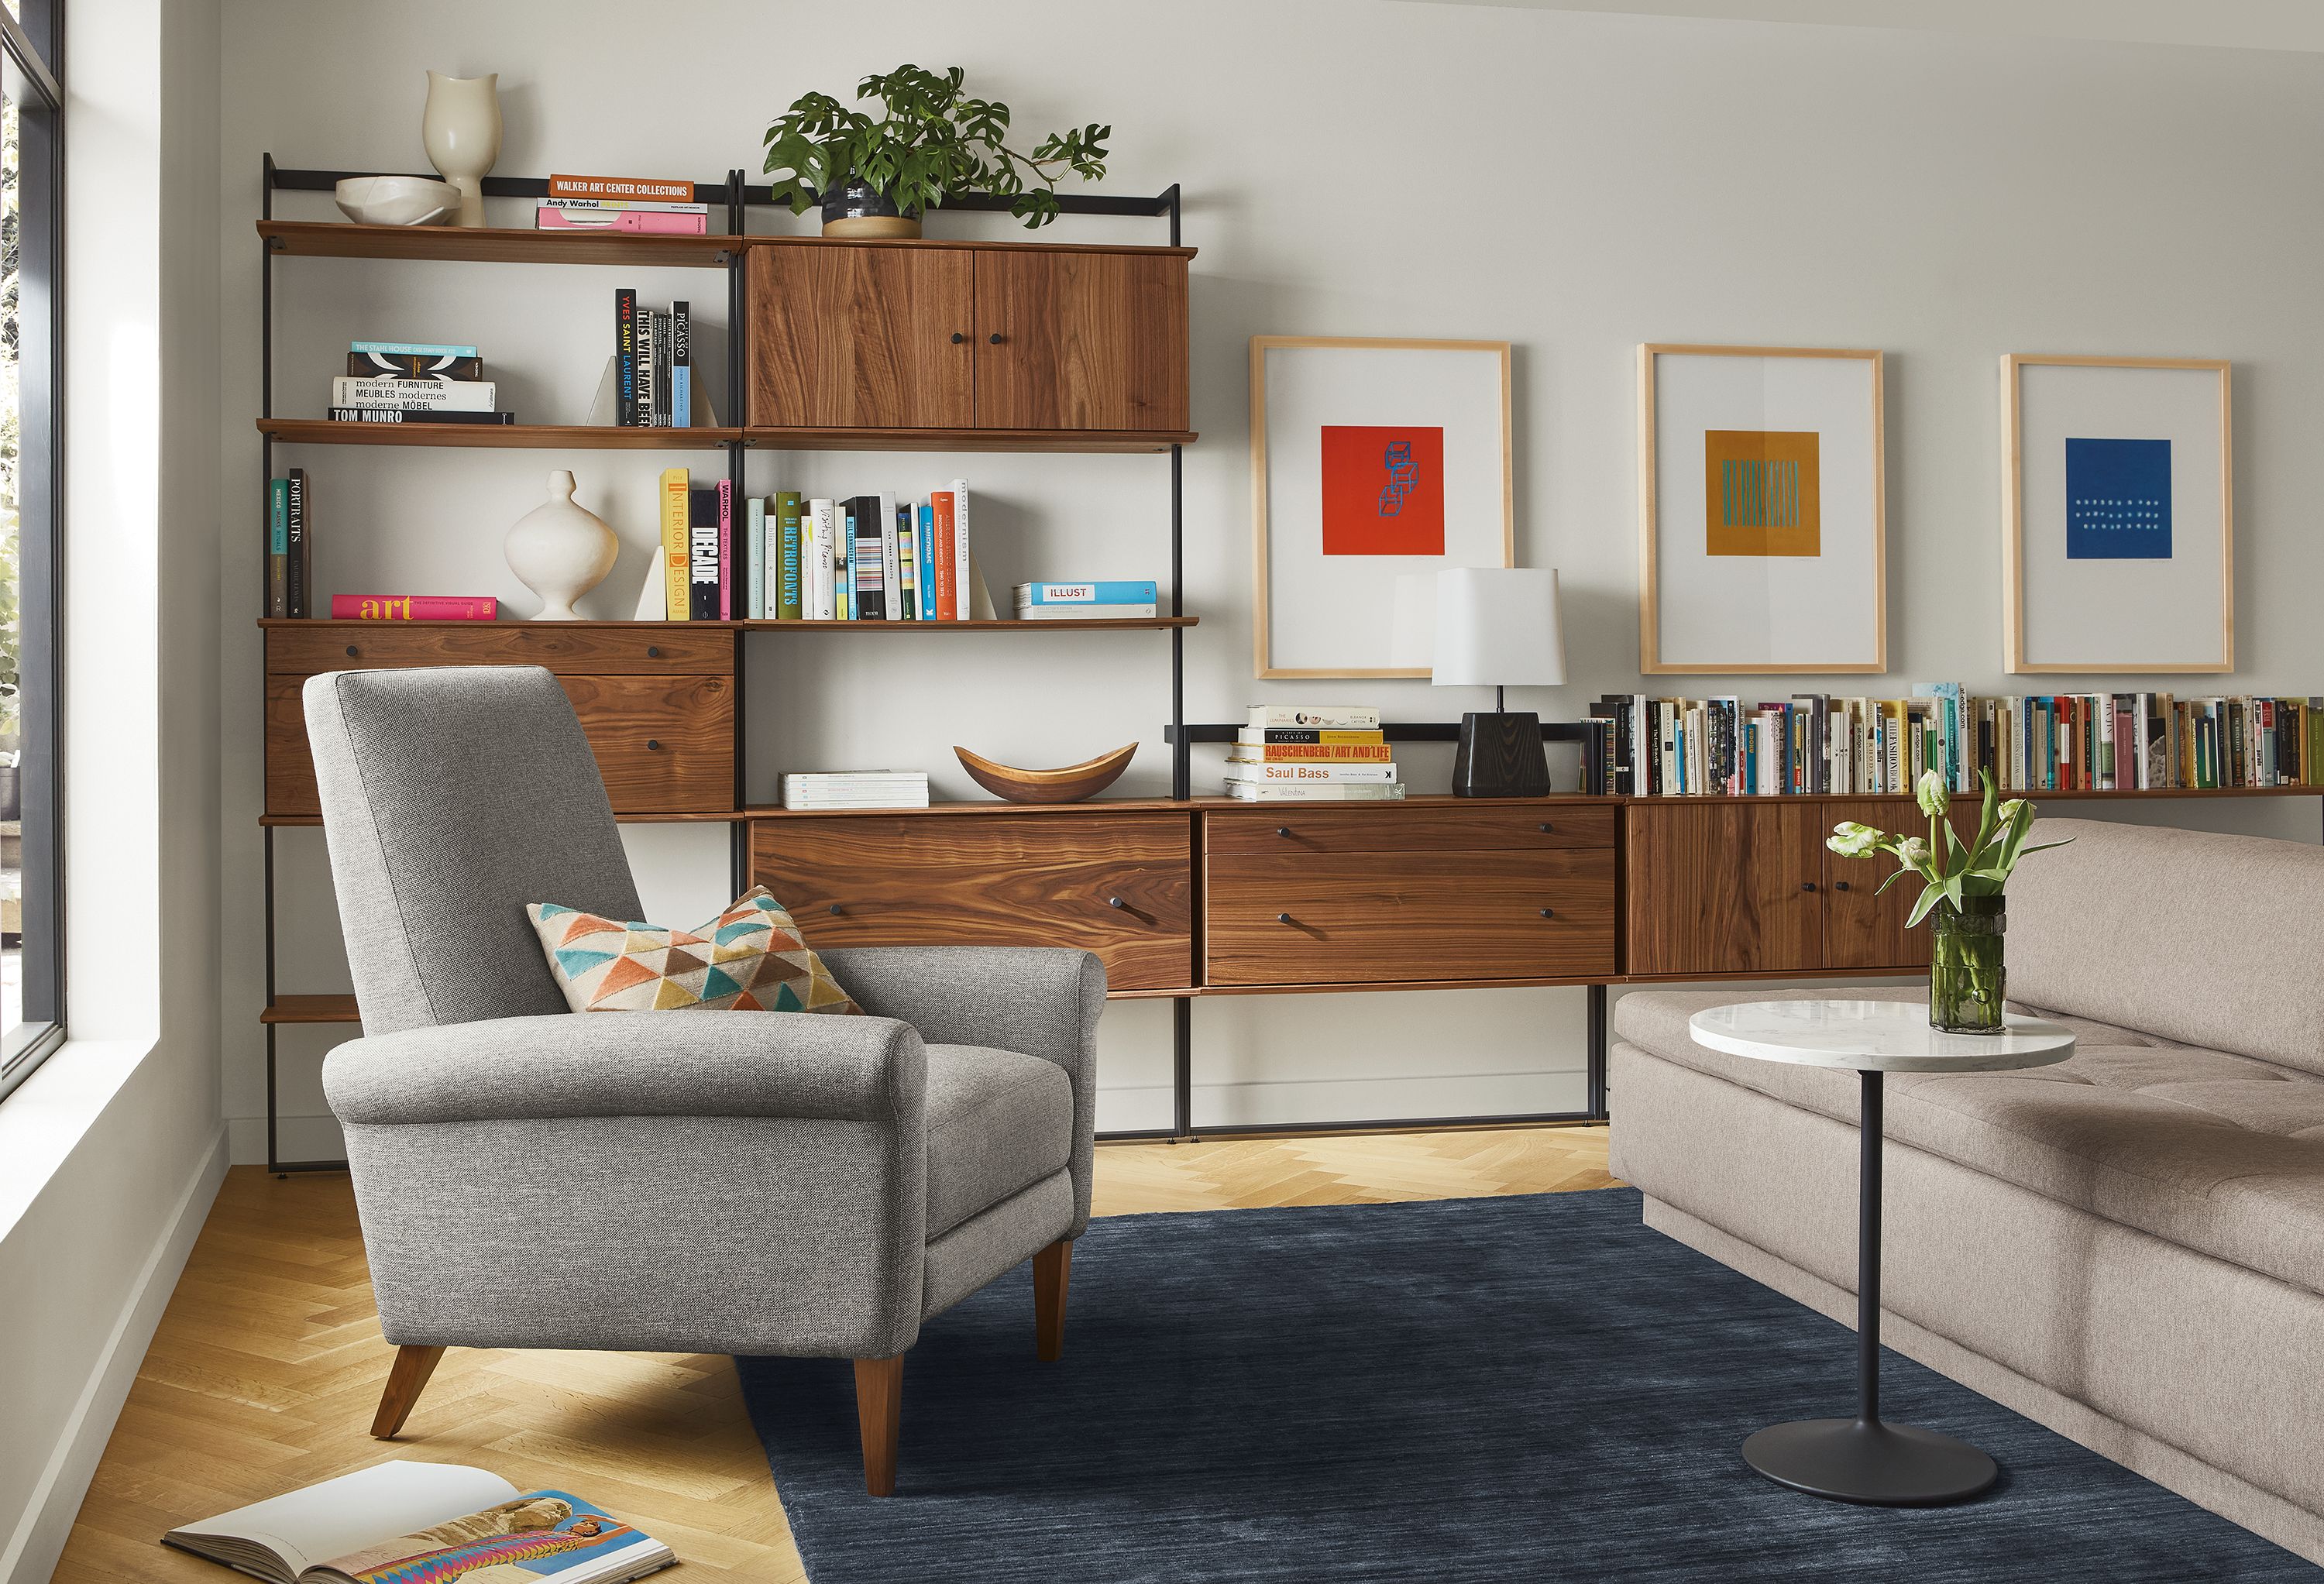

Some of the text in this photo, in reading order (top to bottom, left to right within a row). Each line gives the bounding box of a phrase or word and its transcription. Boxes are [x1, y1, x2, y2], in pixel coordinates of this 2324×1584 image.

[556, 180, 687, 197] WALKER ART CENTER COLLECTIONS
[546, 199, 567, 208] Andy
[569, 200, 599, 208] Warhol
[621, 296, 630, 321] YVES
[638, 311, 650, 335] THIS
[676, 312, 686, 357] PICASSO
[638, 338, 651, 366] WILL
[397, 381, 444, 390] FURNITURE
[623, 355, 632, 400] LAURENT
[638, 369, 651, 400] HAVE
[356, 390, 447, 400] MEUBLES modernes
[356, 400, 433, 411] moderne MÖBEL
[334, 410, 403, 423] TOM MUNRO
[290, 479, 301, 542] PORTRAITS
[669, 483, 688, 606] INTERIOR DESIGN
[817, 508, 833, 569] Visiting Picasso
[692, 527, 719, 585] DECADE
[784, 527, 797, 606] RETROFONTS
[1050, 589, 1086, 597] ILLUST
[360, 595, 414, 620] art
[2106, 703, 2112, 716] HA
[1353, 746, 1370, 758] AND
[1371, 747, 1389, 758] LIFE
[1266, 767, 1329, 778] Saul Bass
